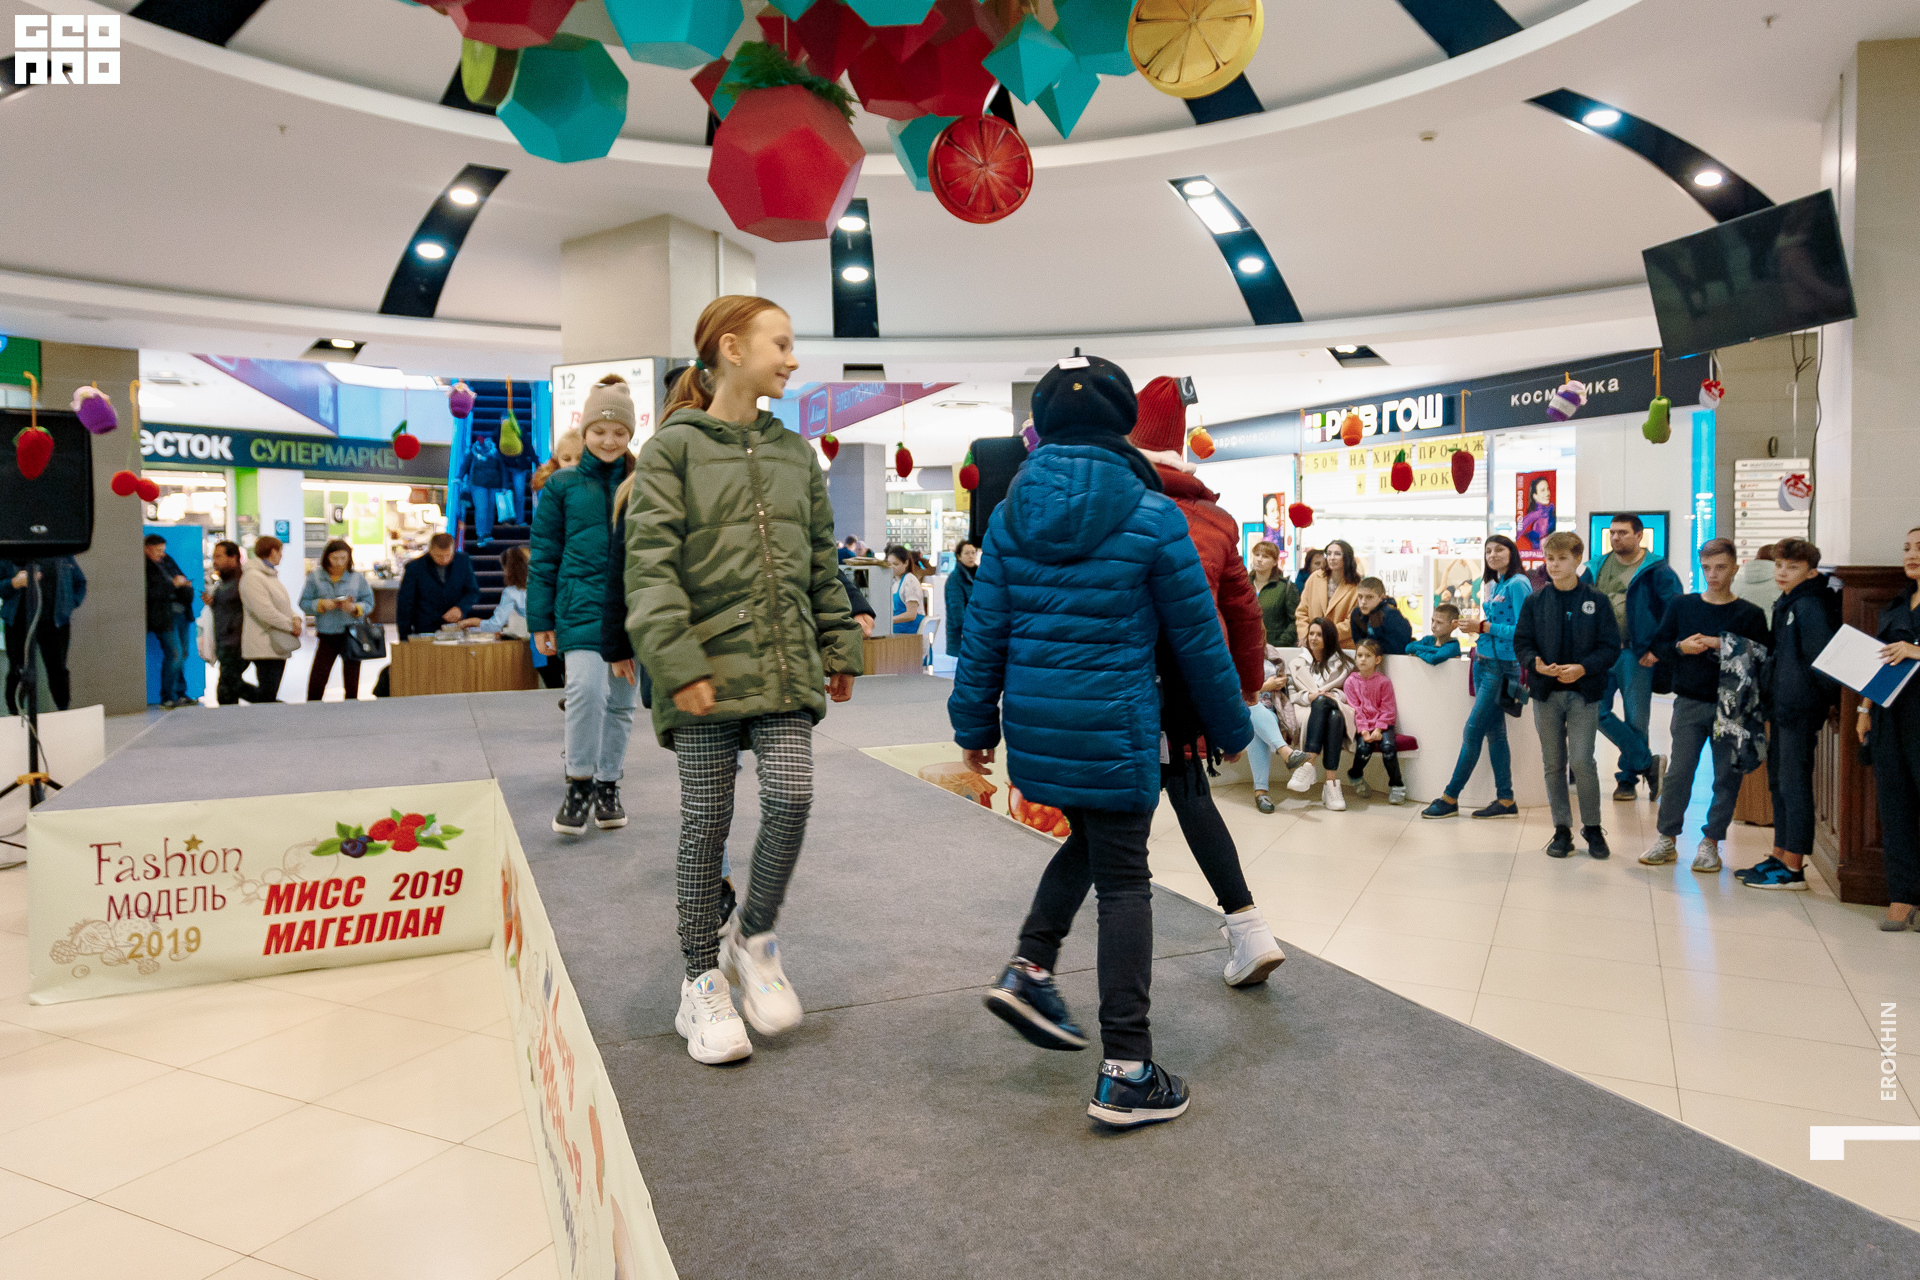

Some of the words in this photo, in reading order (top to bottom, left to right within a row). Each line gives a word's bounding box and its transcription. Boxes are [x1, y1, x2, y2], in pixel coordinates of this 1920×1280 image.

[560, 373, 576, 389] 12
[1510, 377, 1620, 407] космика
[1382, 393, 1443, 435] ГОШ
[1350, 453, 1366, 466] НА
[1380, 472, 1449, 489] ПРОК
[1379, 570, 1408, 582] SHOW
[89, 836, 243, 886] Fashion
[106, 885, 227, 923] МОДЕЛЬ
[263, 875, 366, 916] МИСС
[388, 867, 465, 902] 2019
[126, 926, 202, 961] 2019
[262, 905, 446, 957] МАГЕЛЛАН
